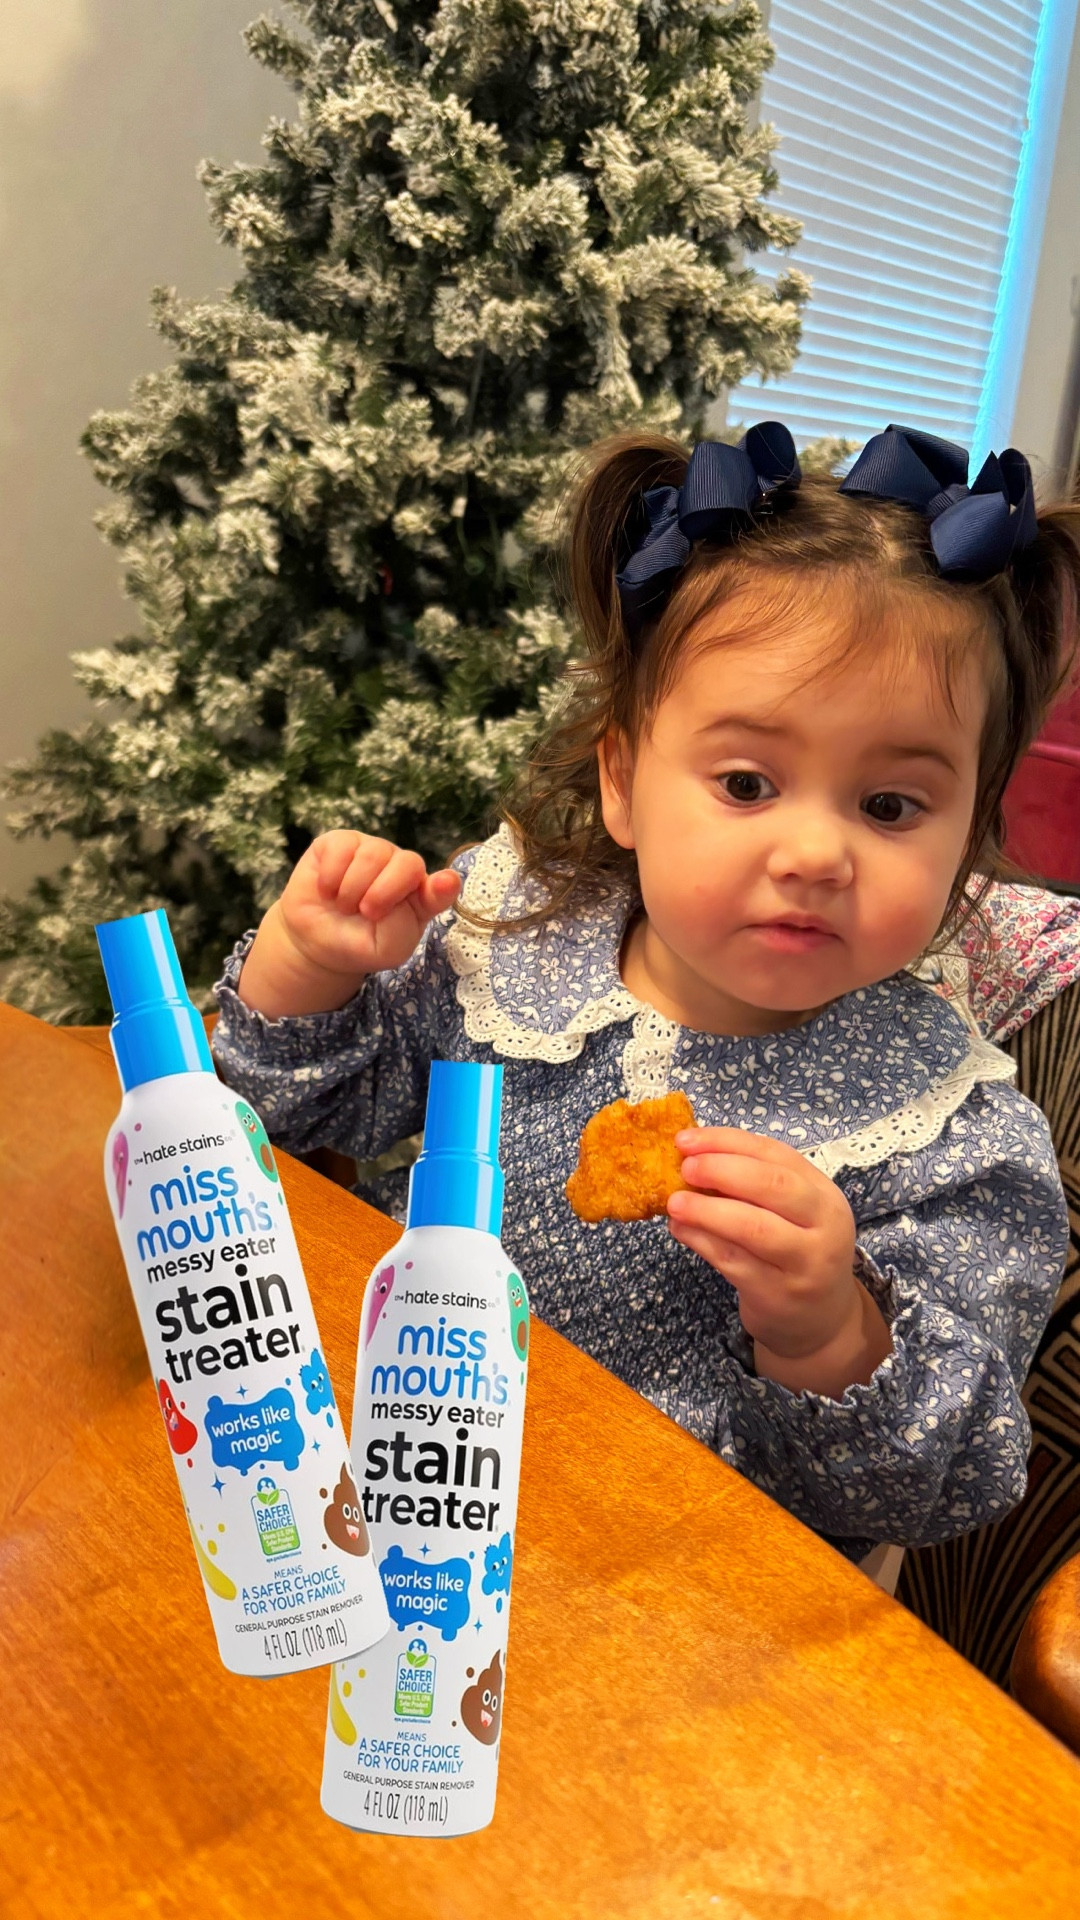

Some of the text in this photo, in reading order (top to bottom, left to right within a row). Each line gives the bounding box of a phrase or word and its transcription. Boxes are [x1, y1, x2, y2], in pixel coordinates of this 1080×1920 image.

[143, 1145, 177, 1164] hate
[179, 1134, 225, 1154] stains
[150, 1165, 239, 1214] miss
[137, 1191, 273, 1262] mouth's
[147, 1237, 276, 1283] messy eater
[155, 1264, 293, 1343] stain
[404, 1290, 439, 1304] hate
[441, 1292, 487, 1310] stains
[165, 1323, 301, 1384] treater
[398, 1316, 487, 1361] miss
[370, 1361, 508, 1405] mouth's
[211, 1405, 291, 1438] works like
[370, 1402, 504, 1428] messy eater
[230, 1428, 282, 1455] magic
[364, 1427, 500, 1490] stain
[256, 1504, 290, 1522] SAFER
[259, 1515, 293, 1532] CHOICE
[361, 1486, 500, 1532] treater
[242, 1565, 340, 1601] A SAFER CHOICE
[274, 1565, 303, 1579] MEANS
[384, 1571, 464, 1593] works like
[243, 1579, 346, 1616] FOR YOUR FAMILY
[395, 1592, 448, 1615] magic
[235, 1594, 364, 1633] GENERAL PURPOSE STAIN REMOVER
[264, 1618, 347, 1661] 4 FL OZ (118 mL)
[398, 1680, 432, 1693] CHOICE
[399, 1668, 432, 1682] SAFER
[359, 1737, 461, 1759] A SAFER CHOICE
[396, 1731, 427, 1742] MEANS
[357, 1753, 464, 1774] FOR YOUR FAMILY
[343, 1770, 475, 1790] GENERAL PURPOSE STAIN REMOVER
[363, 1789, 448, 1826] 4 FL OZ (118 mL)
